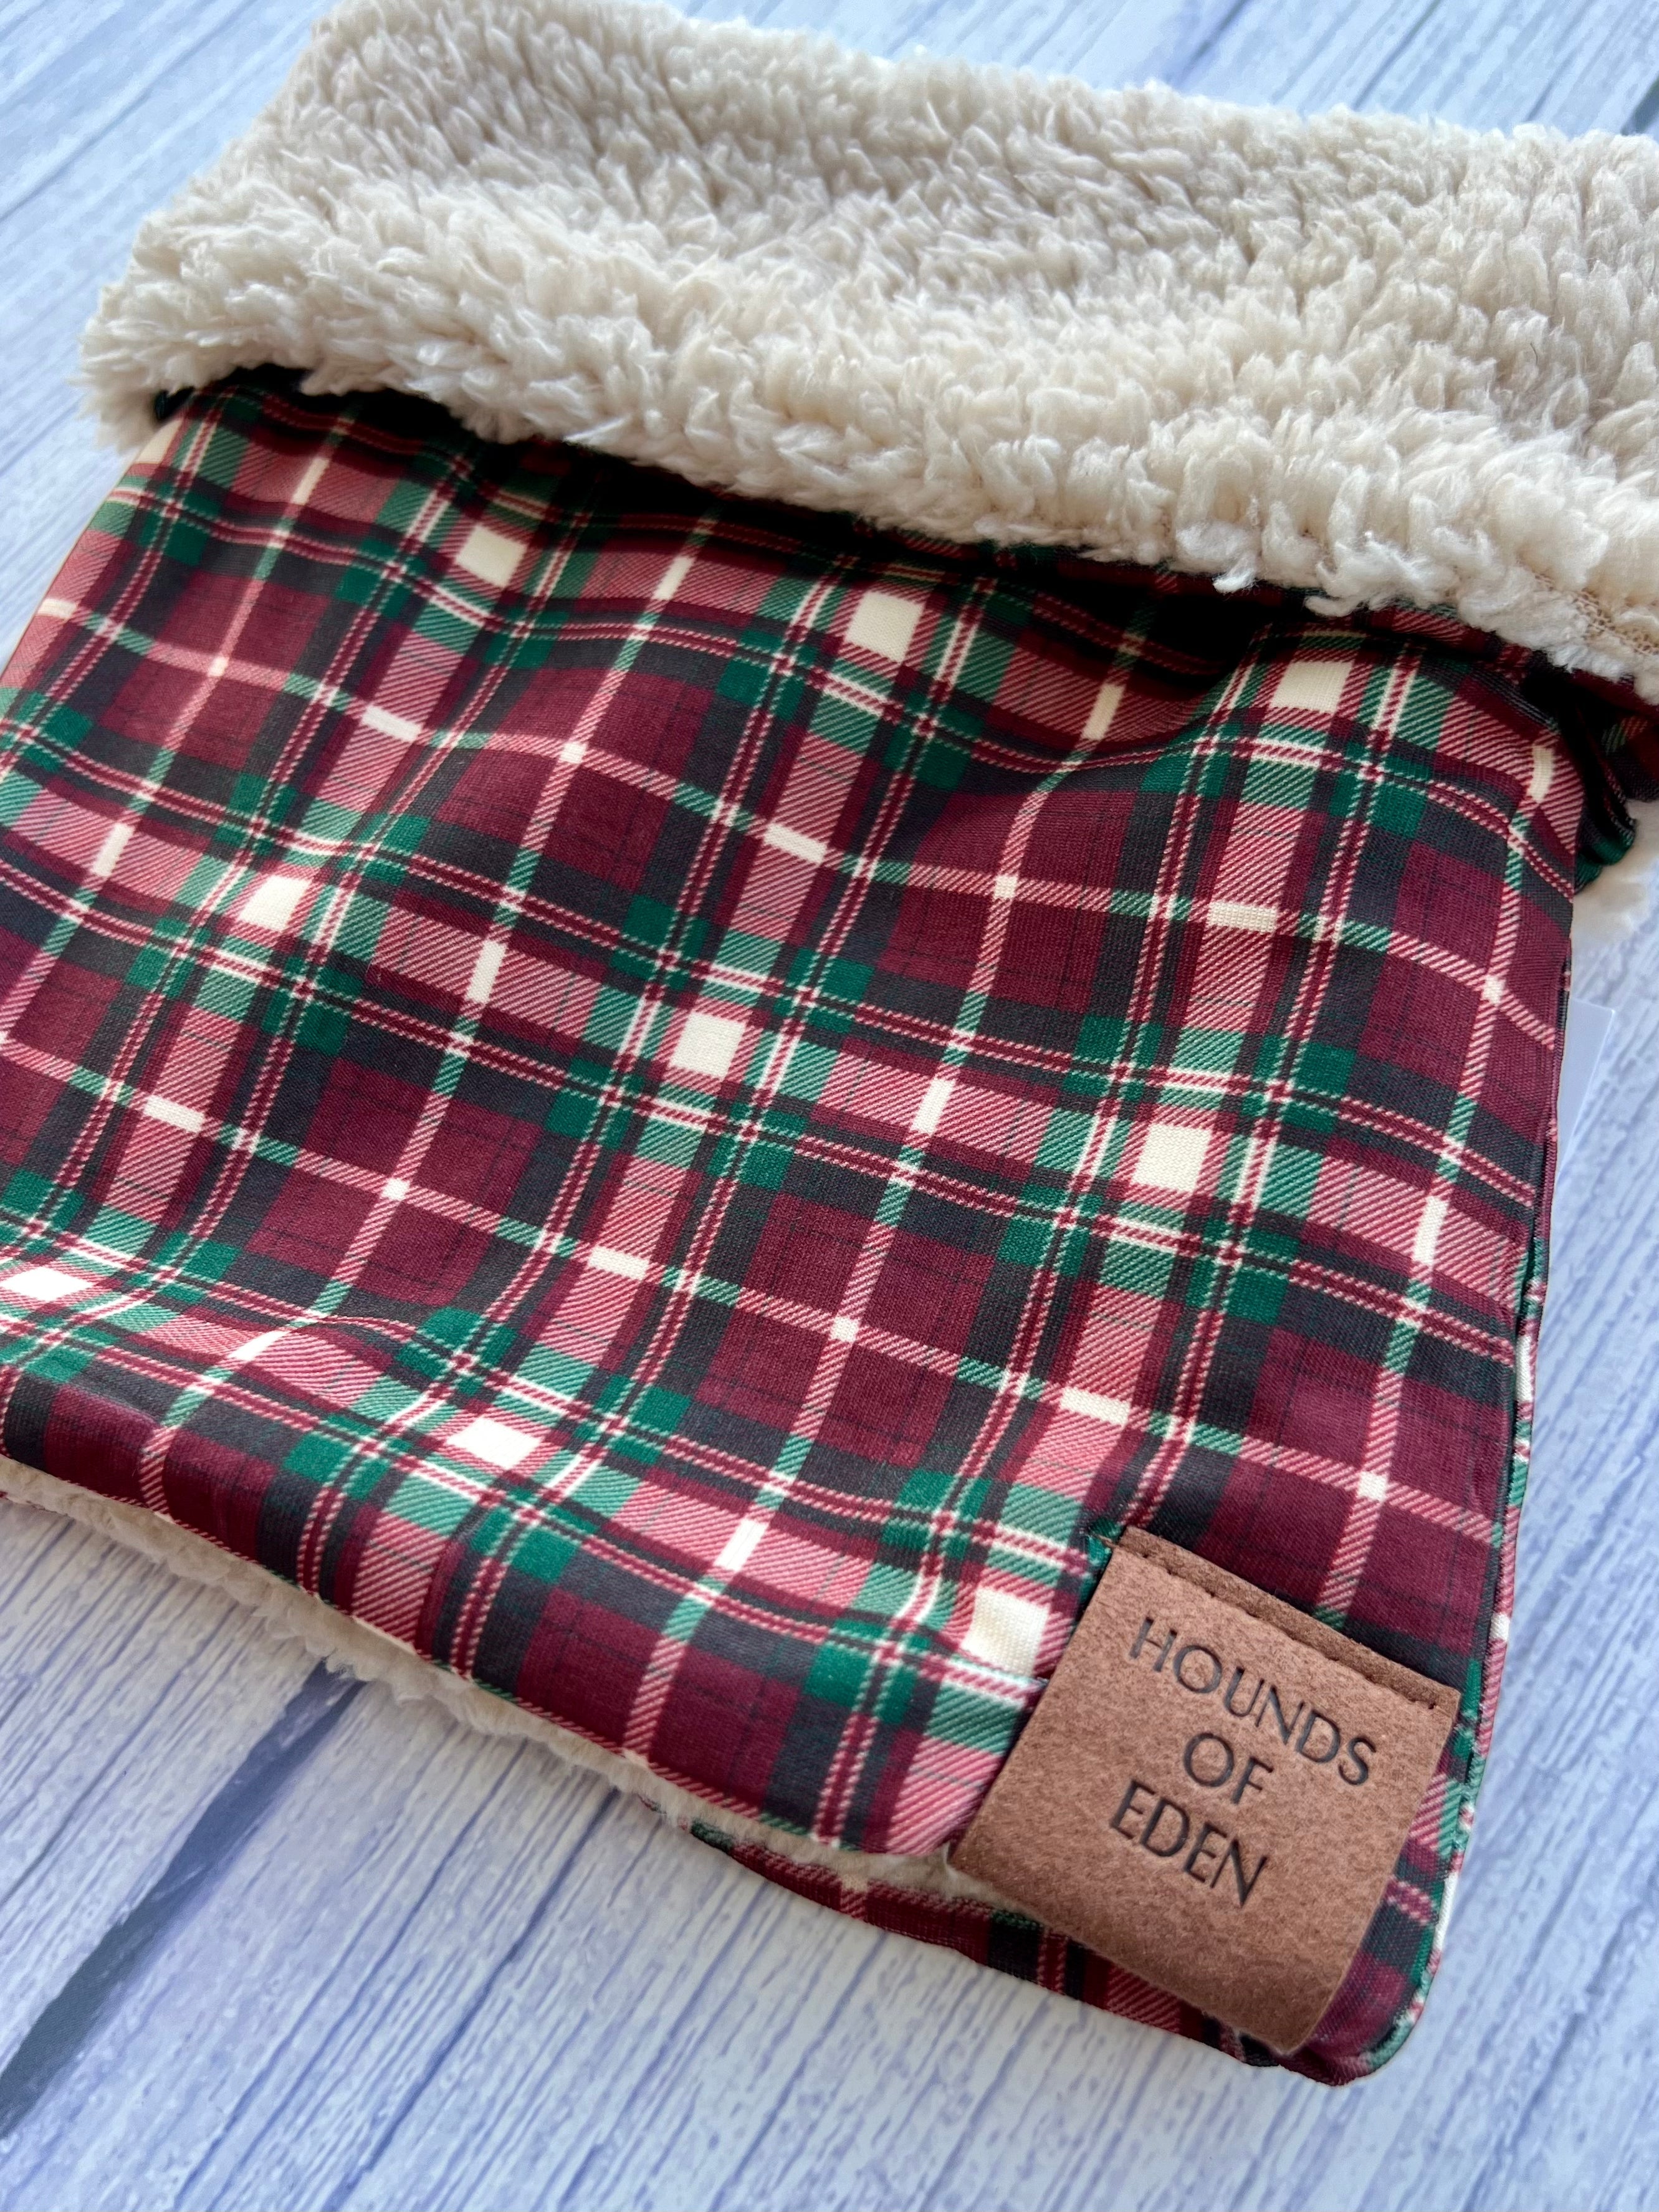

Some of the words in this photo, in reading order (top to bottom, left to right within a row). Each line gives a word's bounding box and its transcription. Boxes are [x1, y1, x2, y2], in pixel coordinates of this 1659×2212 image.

[1129, 1617, 1377, 1786] HOUNDS
[1182, 1731, 1274, 1804] OF
[1110, 1780, 1269, 1907] EDEN
